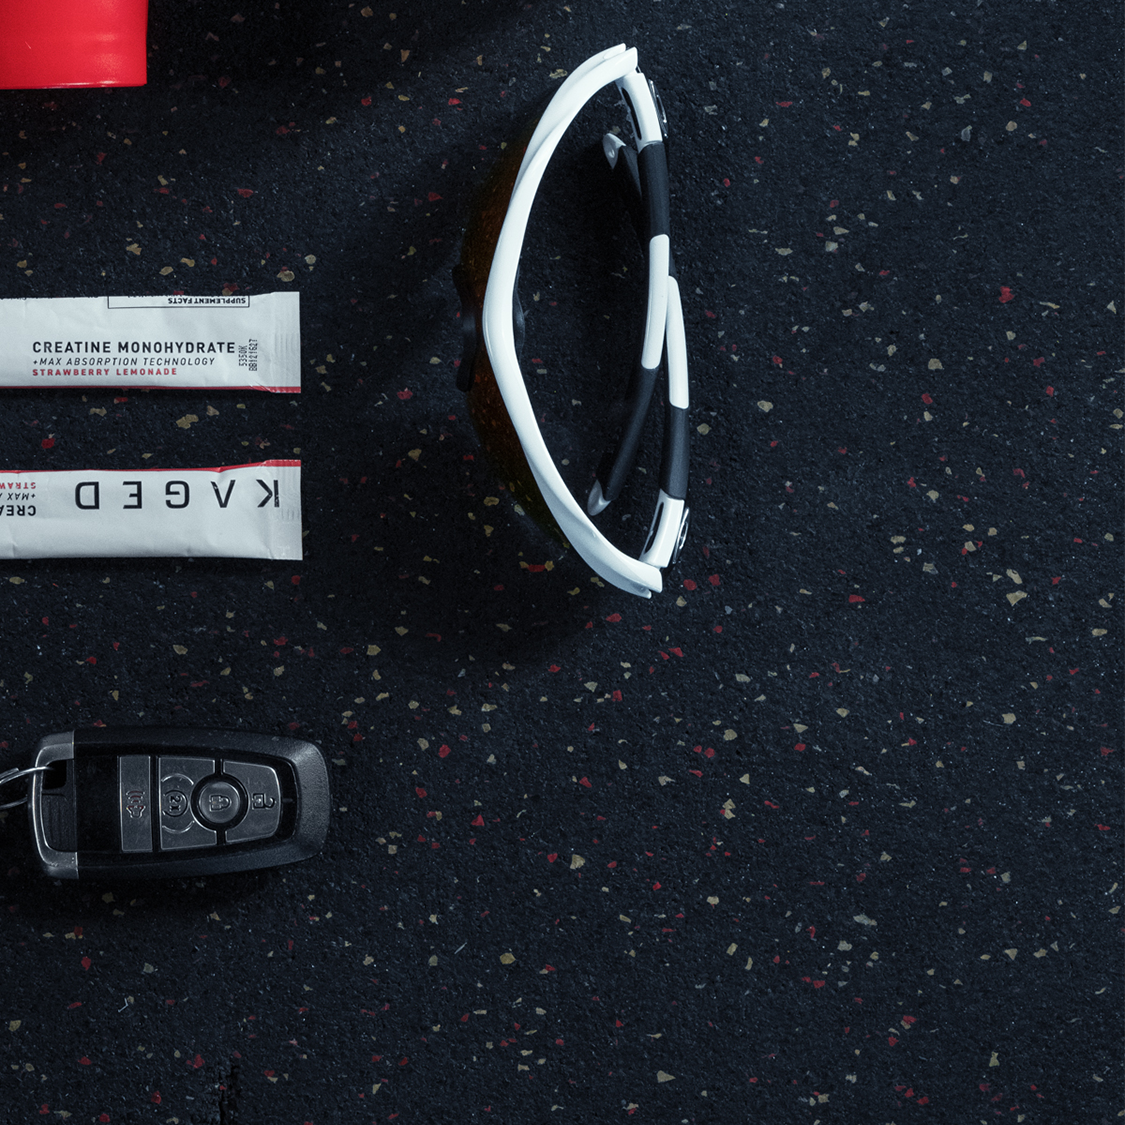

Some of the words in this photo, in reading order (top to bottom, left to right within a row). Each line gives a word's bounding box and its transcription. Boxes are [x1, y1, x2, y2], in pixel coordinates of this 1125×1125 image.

[33, 341, 111, 353] CREATINE
[118, 342, 235, 354] MONOHYDRATE
[66, 357, 138, 366] ABSORPTION
[143, 357, 215, 366] TECHNOLOGY
[32, 368, 110, 376] STRAWBERRY
[116, 367, 177, 376] LEMONADE
